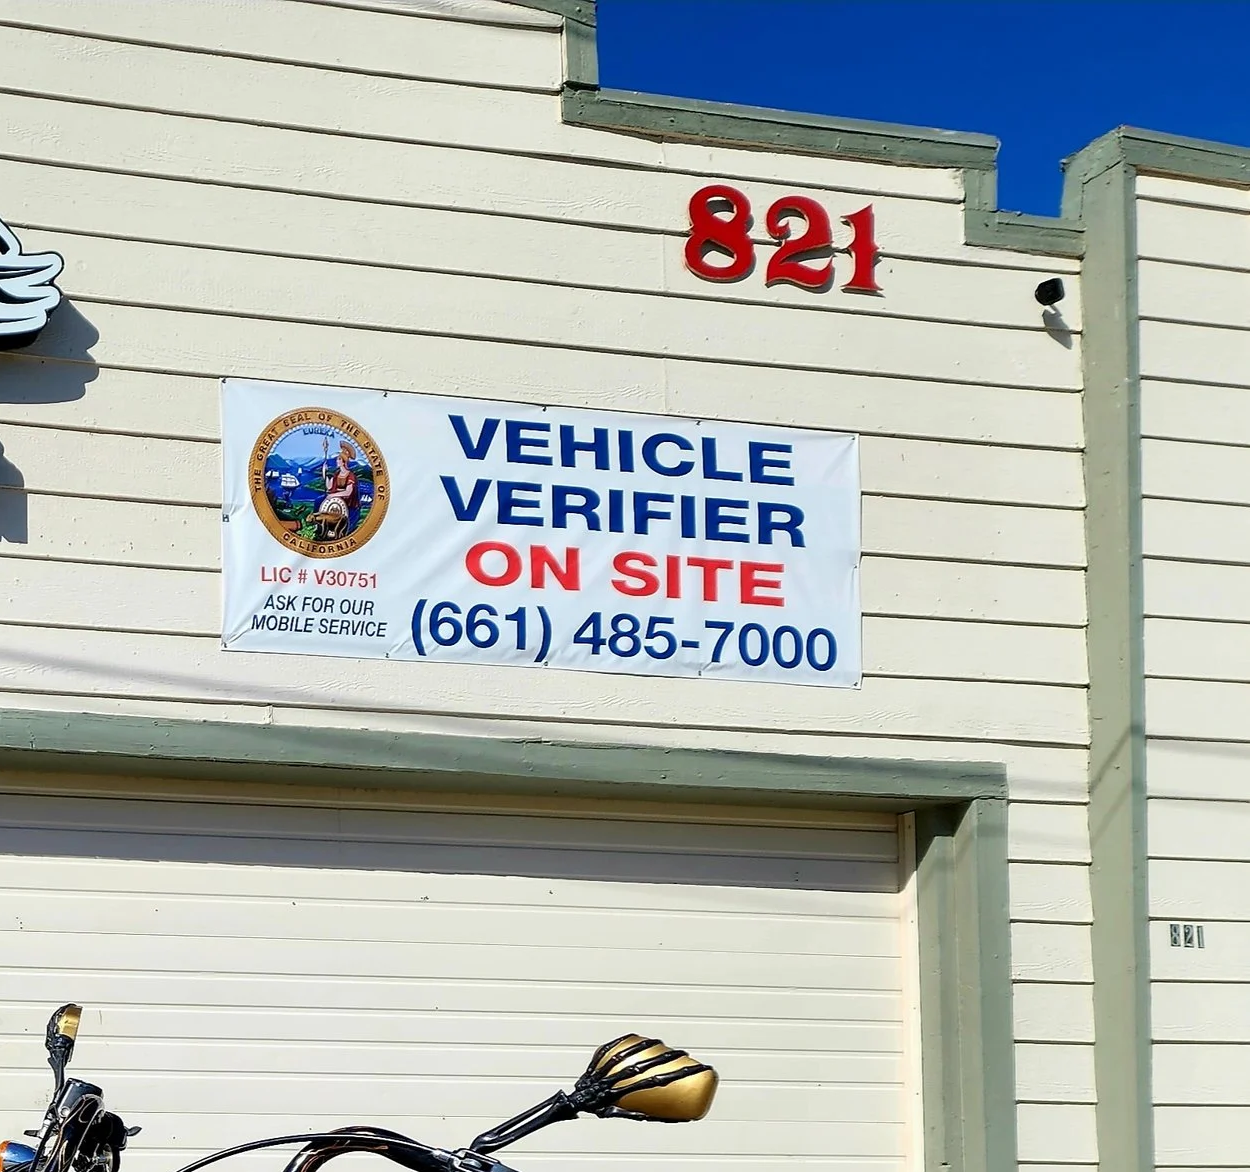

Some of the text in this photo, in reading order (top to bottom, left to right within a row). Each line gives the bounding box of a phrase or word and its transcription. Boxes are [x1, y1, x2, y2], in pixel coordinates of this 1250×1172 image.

[684, 184, 883, 291] 821
[302, 426, 336, 439] EUREKA
[447, 414, 795, 487] VEHICLE
[254, 469, 262, 492] THE
[258, 427, 280, 461] GREAT
[283, 413, 311, 427] SEAL
[341, 419, 360, 438] THE
[363, 441, 385, 476] STATE
[377, 485, 385, 501] OF
[439, 475, 806, 548] VERIFIER
[282, 532, 357, 554] CALIFORNIA
[260, 566, 378, 589] LIC # V30751
[465, 540, 785, 607] ON SITE
[251, 614, 388, 638] MOBILE SERVICE
[263, 594, 375, 616] ASK FOR OUR
[411, 598, 838, 672] (661) 485-7000
[1170, 923, 1205, 948] 821
